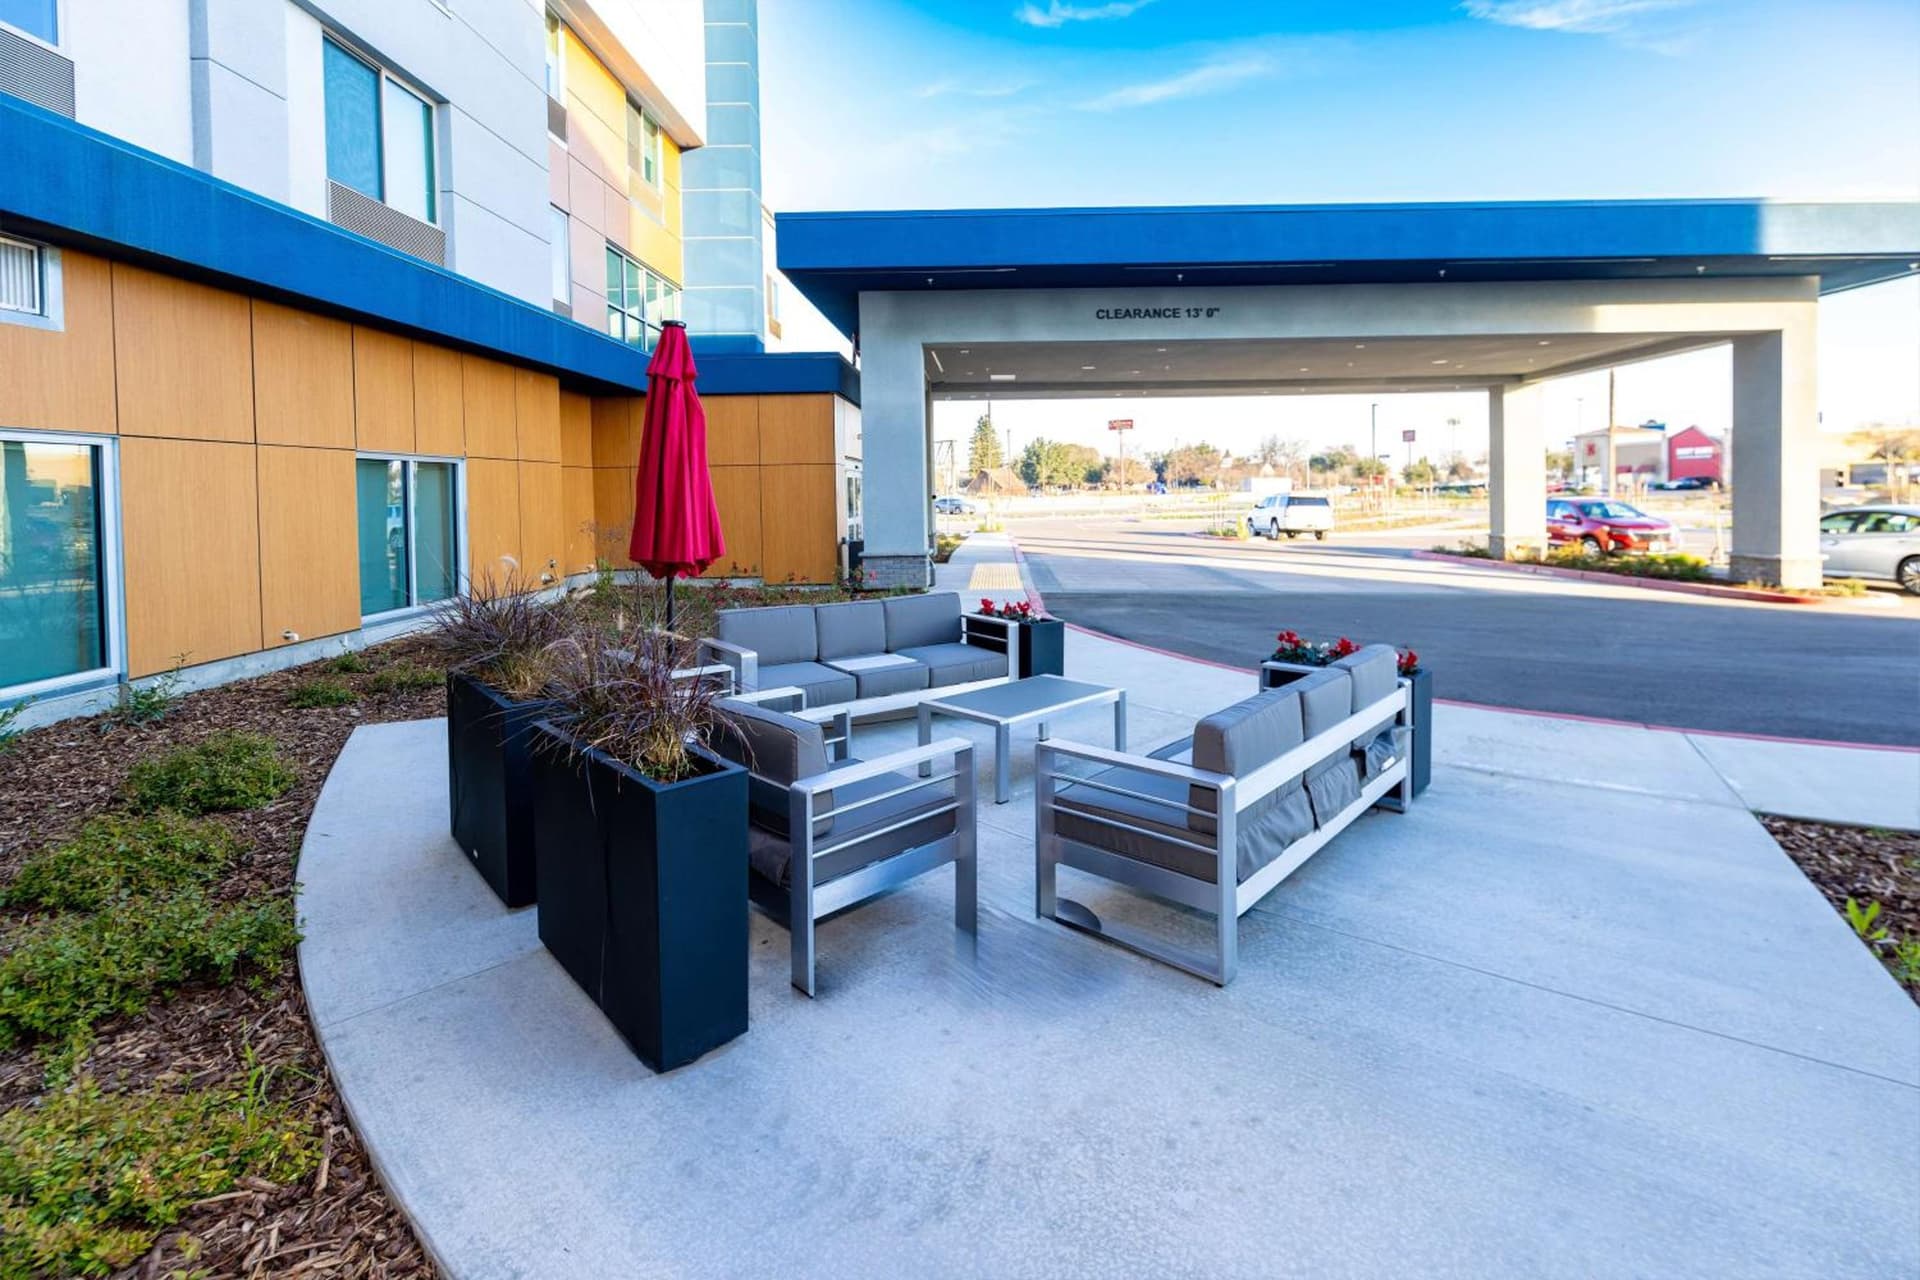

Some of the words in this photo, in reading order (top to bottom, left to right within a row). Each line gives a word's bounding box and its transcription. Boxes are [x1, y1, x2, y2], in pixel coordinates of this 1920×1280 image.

[1096, 308, 1181, 320] CLEARANCE
[1186, 308, 1202, 319] 13'
[1206, 307, 1220, 318] 0"
